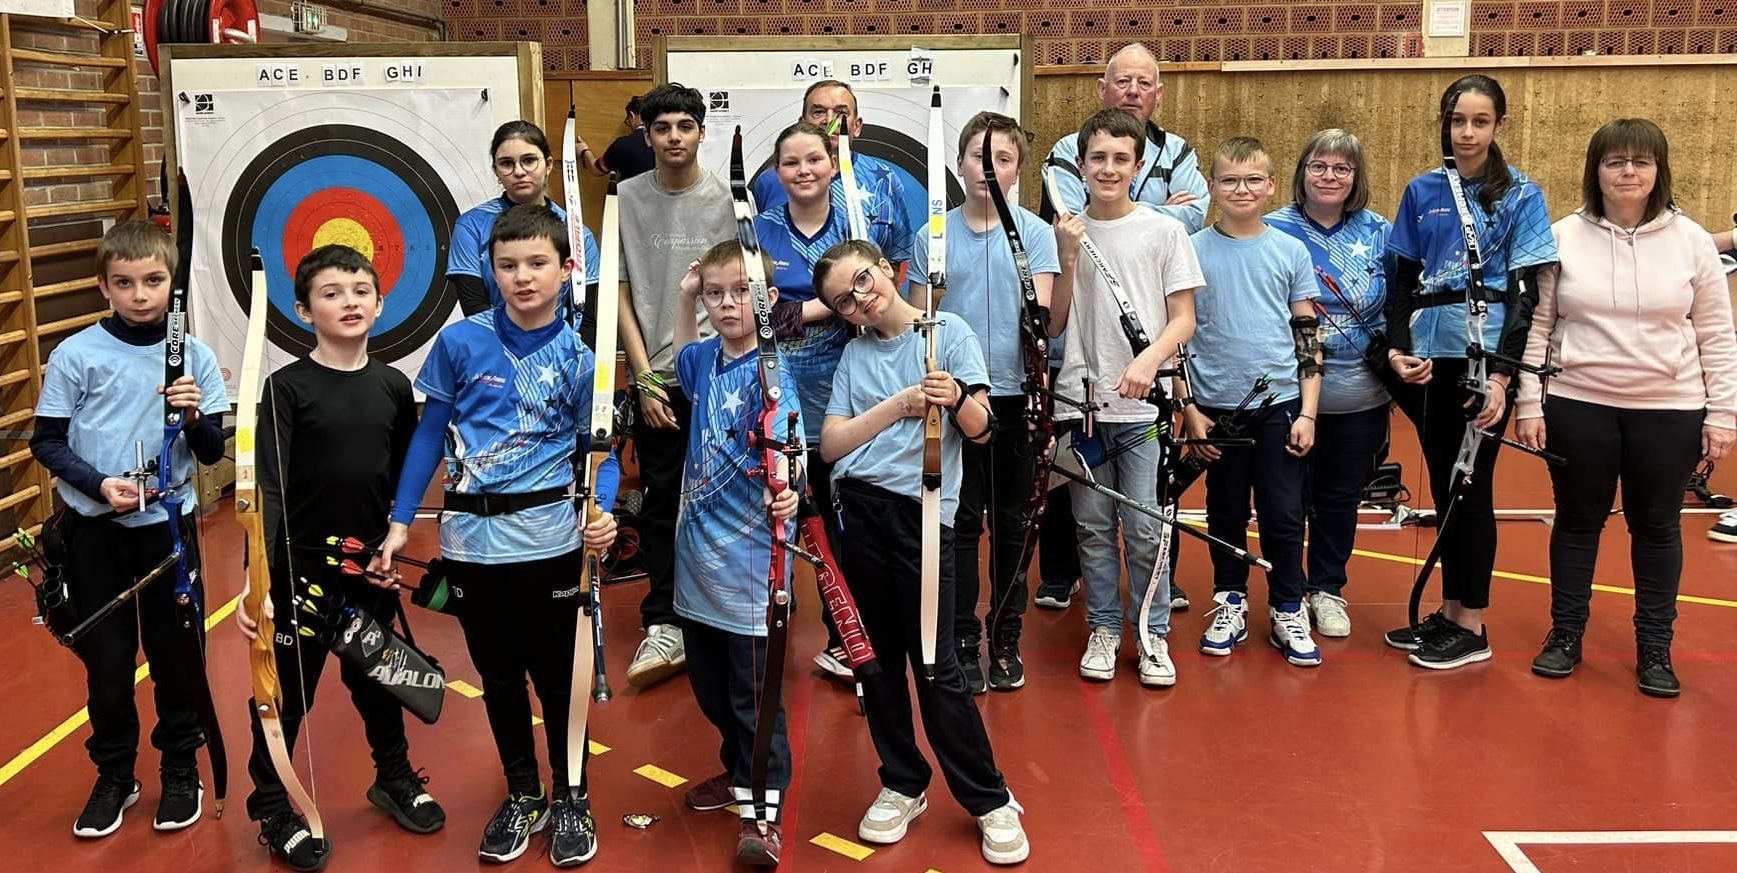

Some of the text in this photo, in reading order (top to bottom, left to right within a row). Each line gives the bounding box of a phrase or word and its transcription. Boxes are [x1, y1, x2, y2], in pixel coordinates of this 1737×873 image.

[259, 65, 422, 81] ACE BDF GHI
[851, 62, 887, 76] BDF
[907, 62, 932, 75] GH
[170, 326, 180, 353] CORE
